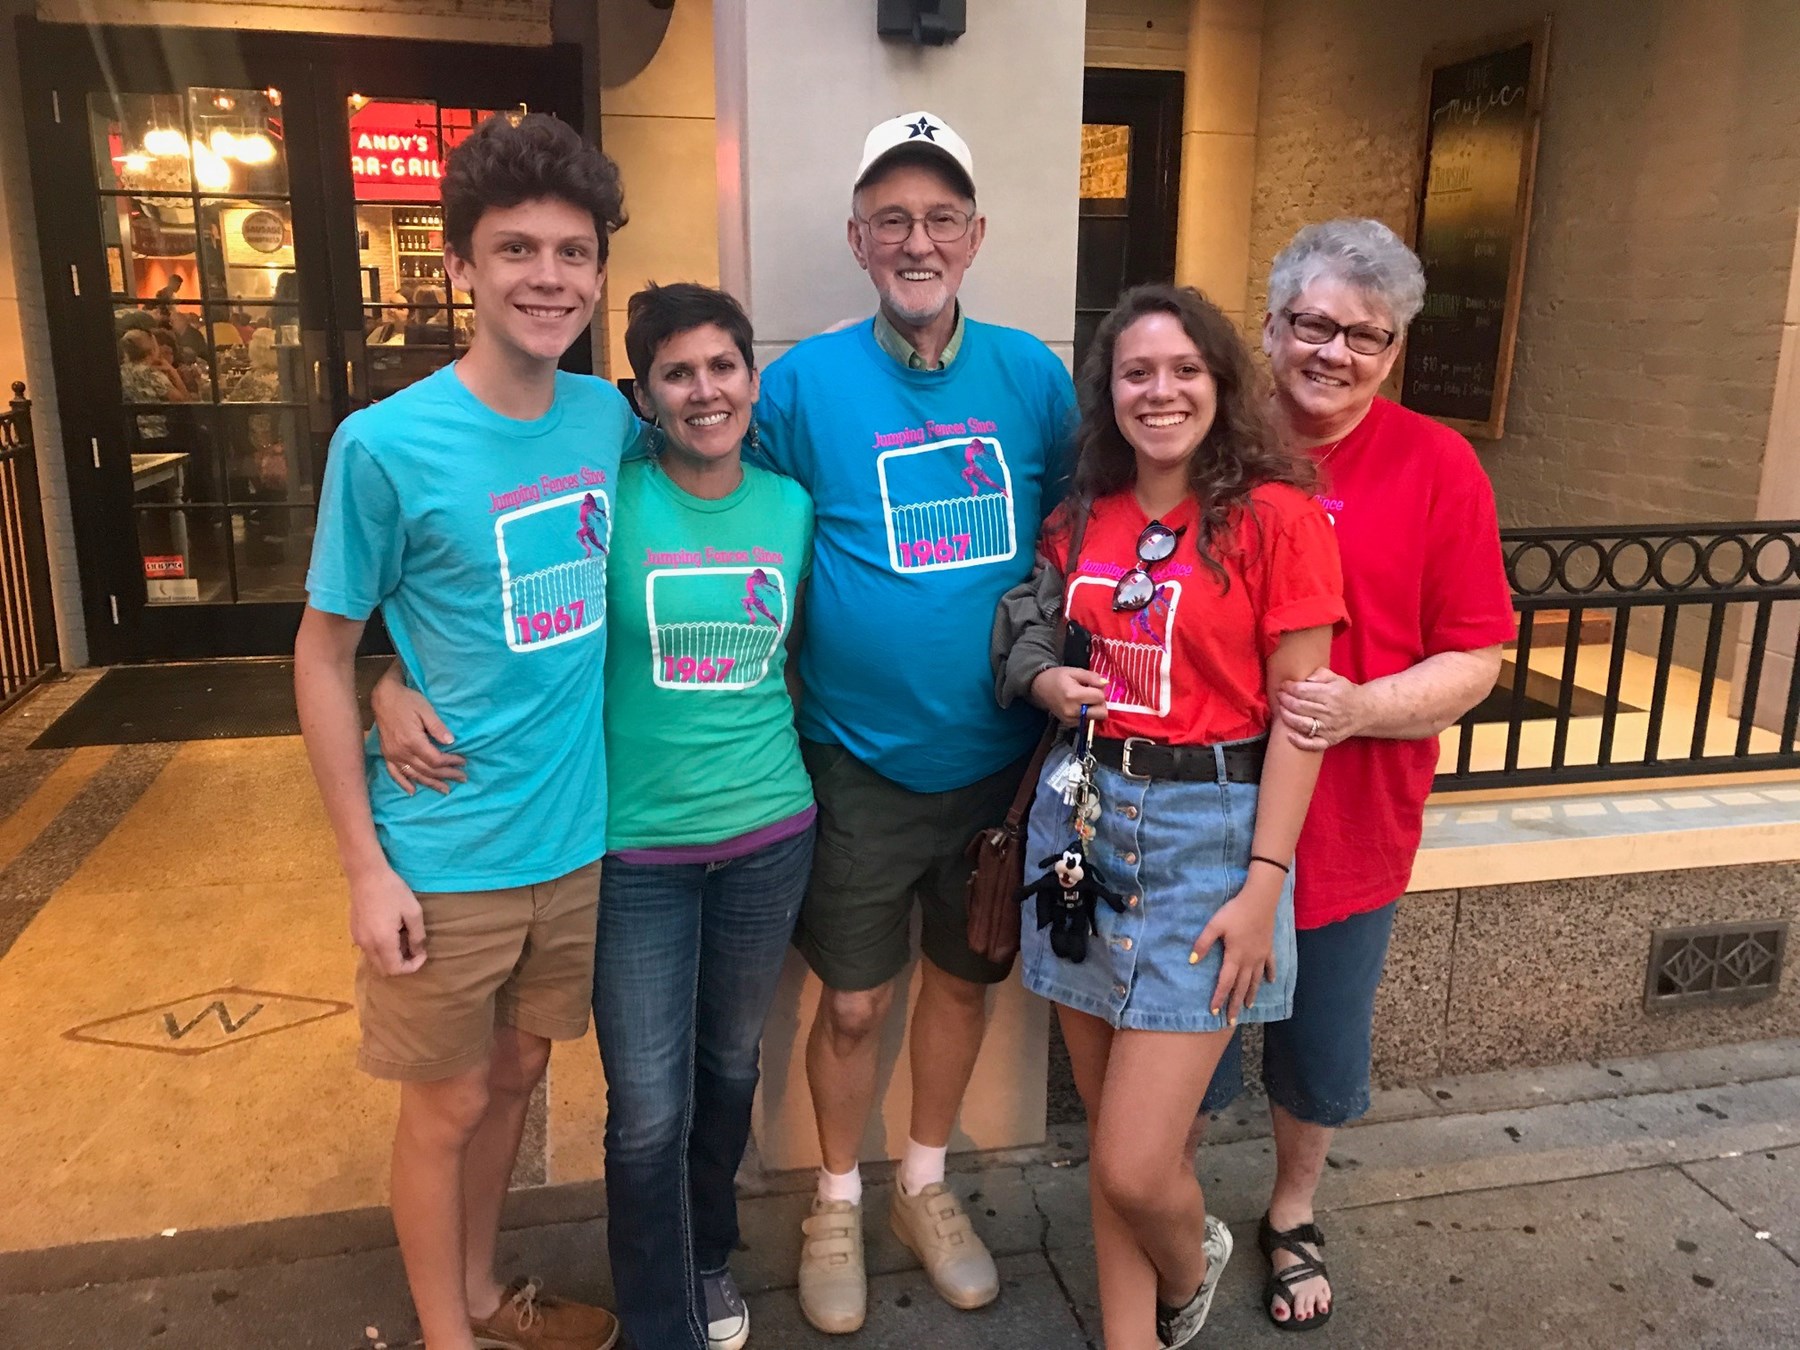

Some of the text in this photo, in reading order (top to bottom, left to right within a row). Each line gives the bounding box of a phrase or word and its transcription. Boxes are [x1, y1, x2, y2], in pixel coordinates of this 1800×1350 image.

[357, 133, 428, 152] ANDY'S
[351, 156, 442, 178] AR-GRIL
[871, 417, 998, 449] Jumping Fences Since
[489, 466, 606, 514] Jumping Fences Since
[1314, 494, 1345, 511] nce
[643, 545, 784, 569] Jumping Fences Since
[900, 533, 971, 568] 1967
[515, 599, 585, 644] 1967
[663, 655, 736, 683] 1967
